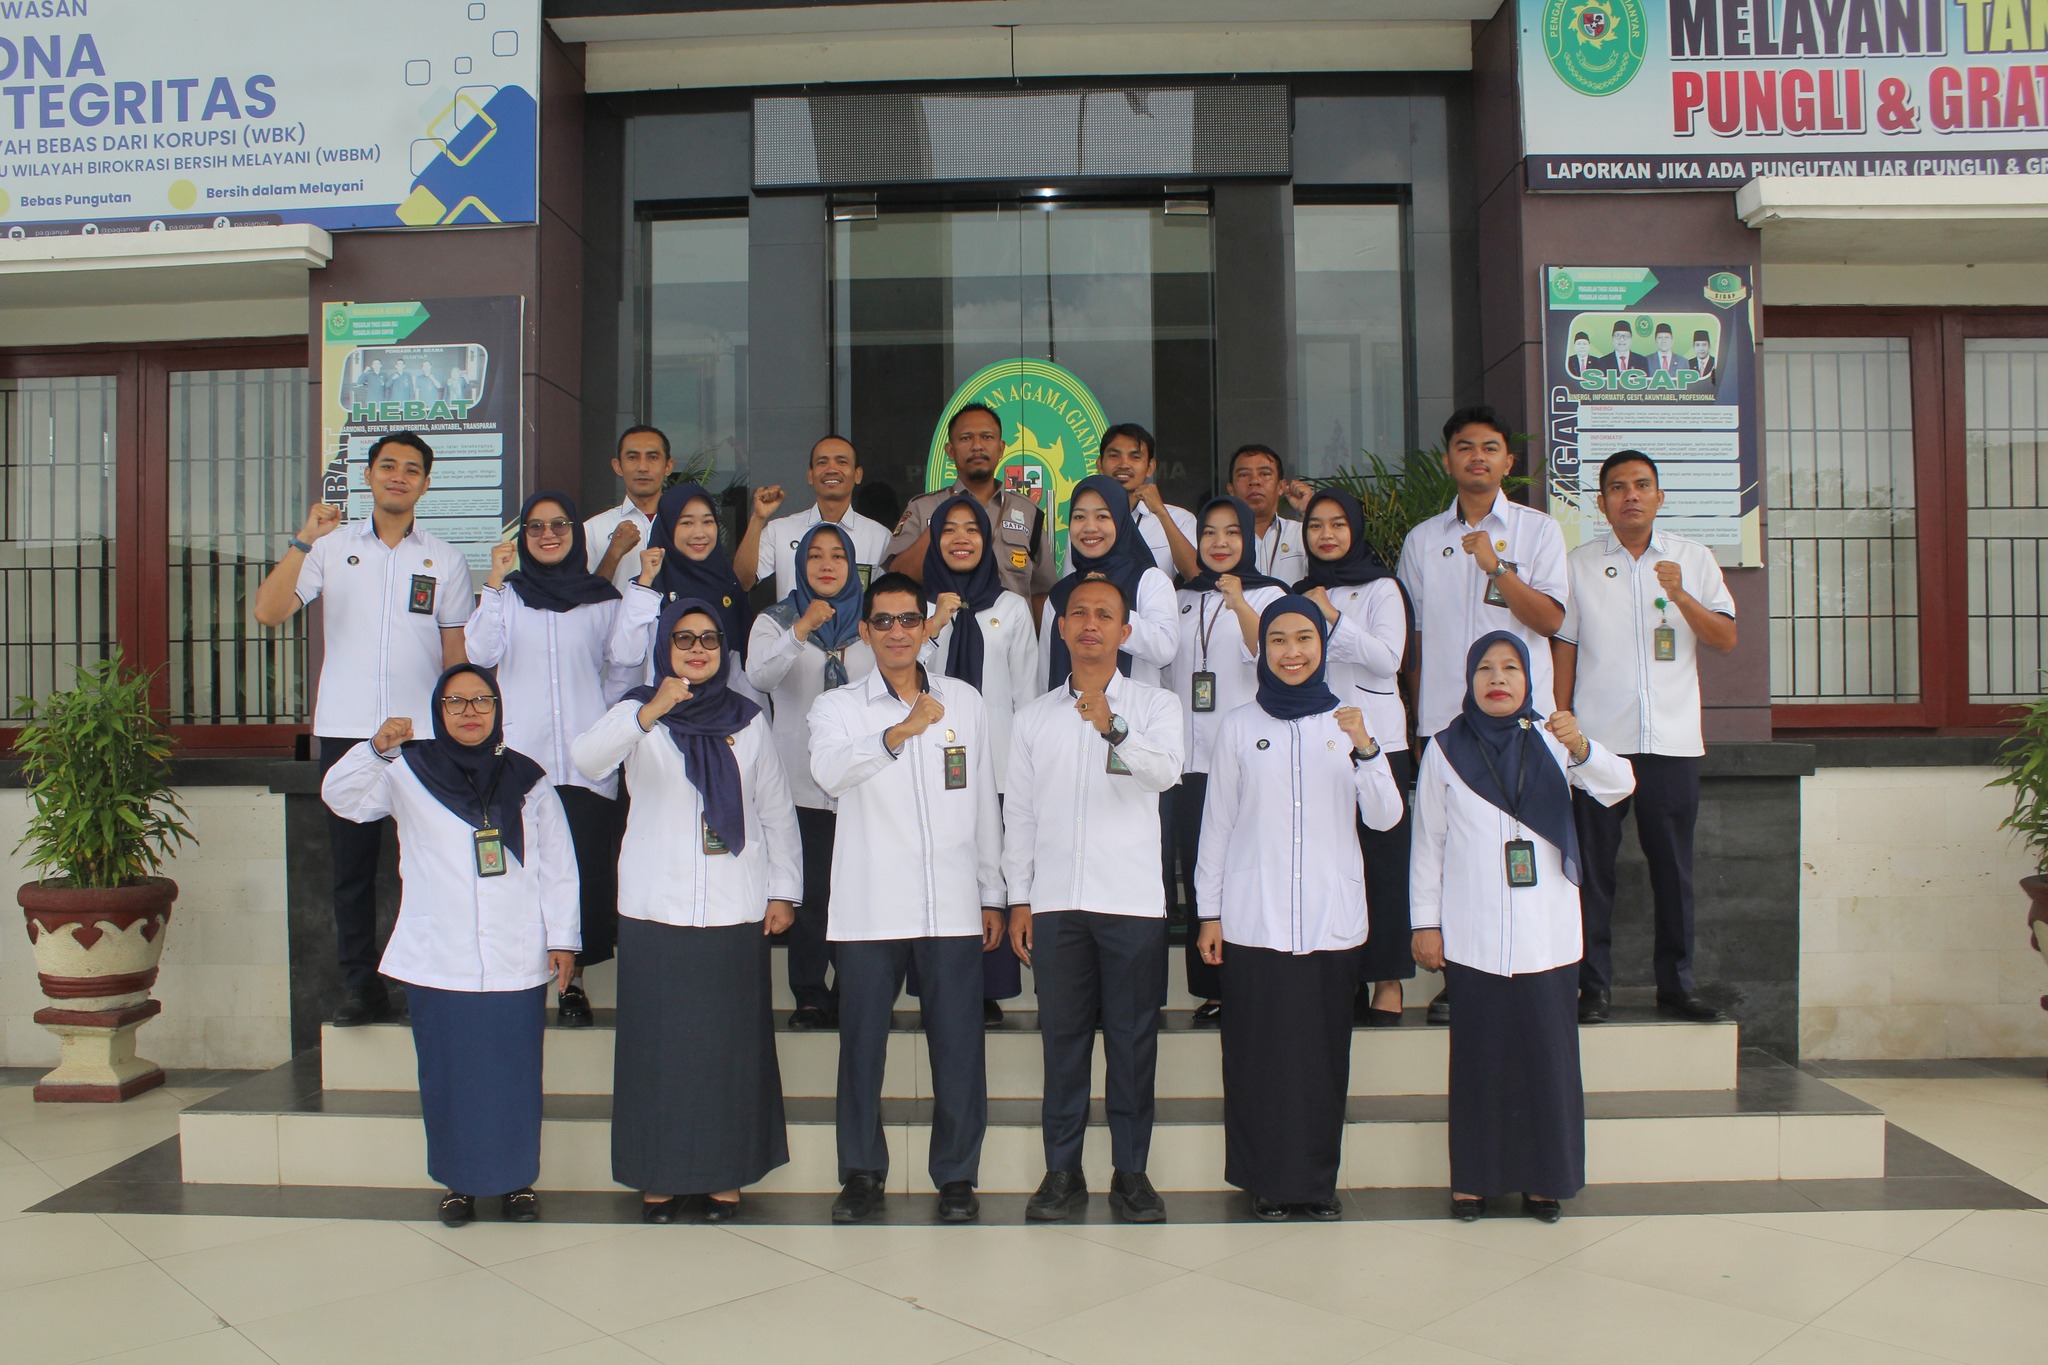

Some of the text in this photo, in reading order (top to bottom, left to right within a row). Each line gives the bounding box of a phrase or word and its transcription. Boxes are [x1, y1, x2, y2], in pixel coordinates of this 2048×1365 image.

[1670, 0, 1945, 59] MELAYANI
[3, 75, 277, 130] TEGRITAS
[1671, 68, 1866, 136] PUNGLI
[1877, 77, 1919, 134] &
[37, 137, 97, 154] BEBAS
[103, 134, 148, 151] DARI
[153, 130, 237, 149] KORUPSI
[243, 122, 306, 148] (WBK)
[12, 161, 83, 177] WILAYAH
[88, 158, 170, 174] BIROKRASI
[174, 155, 228, 170] BERSIH
[232, 151, 311, 167] MELAYANI
[315, 144, 381, 166] (WBBM)
[1547, 162, 1650, 180] LAPORKAN
[1657, 162, 1702, 179] JIKA
[1707, 161, 1746, 179] ADA
[1752, 160, 1858, 177] PUNGUTAN
[1864, 159, 1907, 176] LIAR
[1913, 158, 1999, 176] (PUNGLI)
[2006, 158, 2020, 175] &
[20, 193, 132, 208] Bebas Pungutan
[206, 179, 364, 199] Bersih dalam Melayani
[1580, 369, 1700, 391] SIGAP
[352, 399, 474, 422] HEBAT
[1009, 382, 1069, 416] AGAMA
